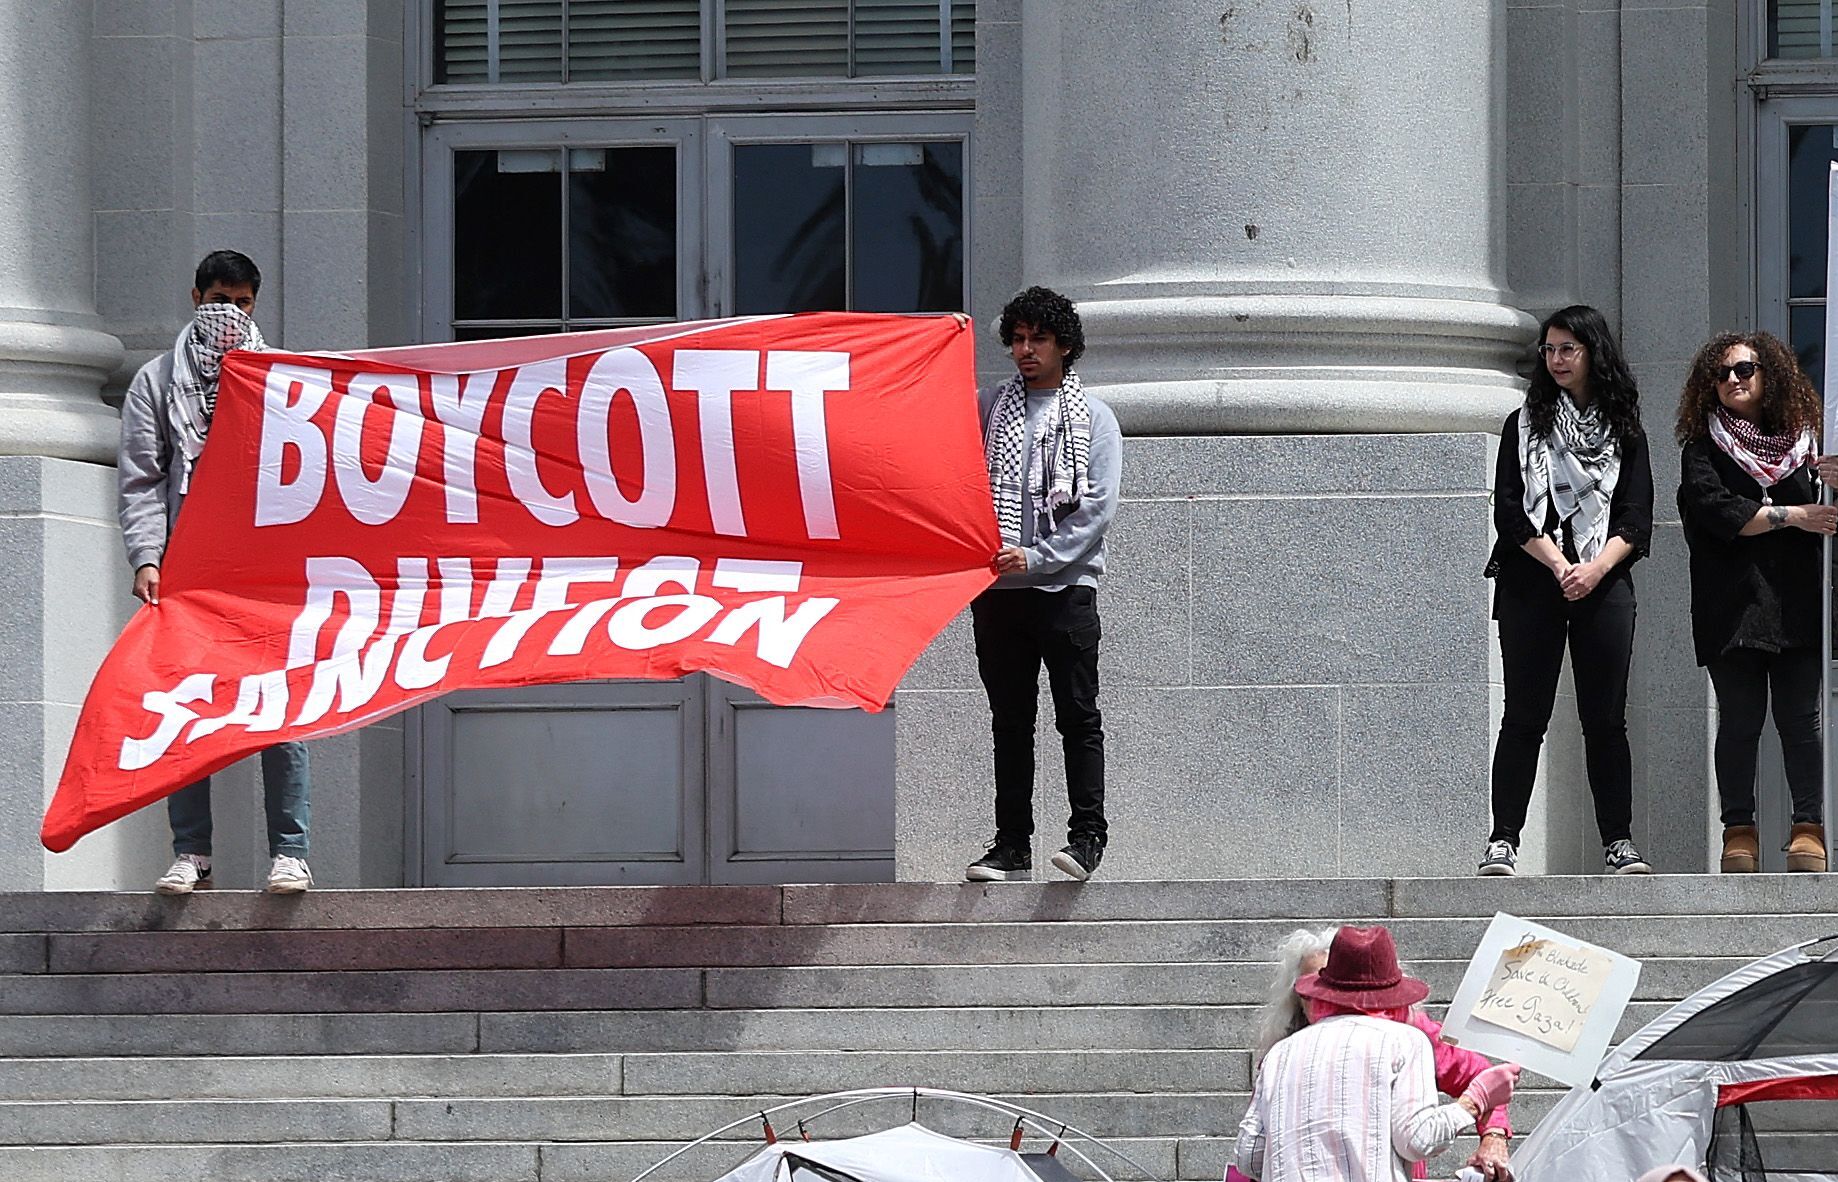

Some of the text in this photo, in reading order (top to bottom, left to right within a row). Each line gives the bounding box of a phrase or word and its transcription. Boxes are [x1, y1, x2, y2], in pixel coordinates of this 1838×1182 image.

[254, 346, 852, 540] BOYCOTT
[118, 594, 840, 771] SANCTION
[1479, 988, 1576, 1035] Free Gaza!
[1500, 960, 1535, 982] Save
